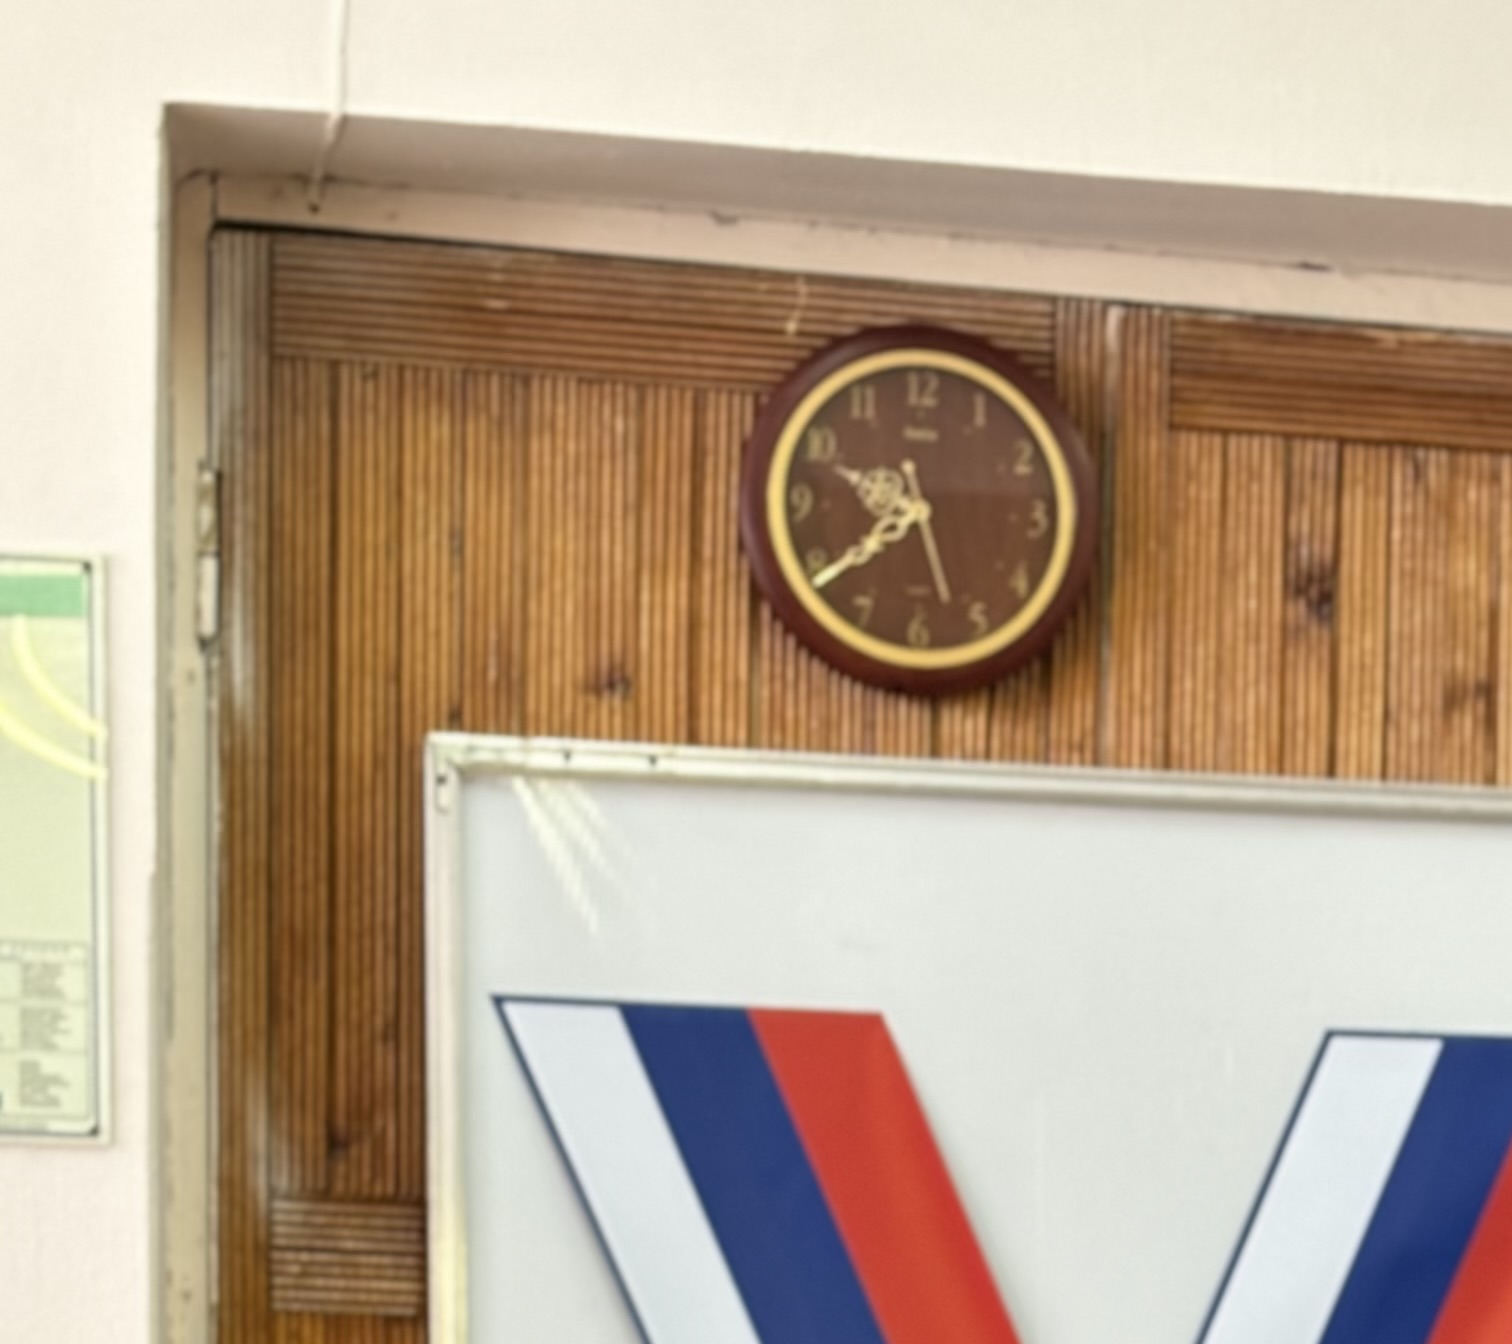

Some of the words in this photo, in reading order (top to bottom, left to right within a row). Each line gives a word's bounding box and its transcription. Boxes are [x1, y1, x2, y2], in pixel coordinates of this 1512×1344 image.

[850, 383, 875, 419] 11
[905, 371, 939, 407] 12
[974, 391, 986, 427] 1
[806, 425, 837, 462] 10
[1013, 437, 1034, 475] 2
[789, 482, 813, 523] 9
[1027, 499, 1049, 539] 3
[1009, 561, 1029, 599] 4
[852, 594, 874, 629] 7
[906, 603, 931, 648] 6
[968, 602, 988, 635] 5
